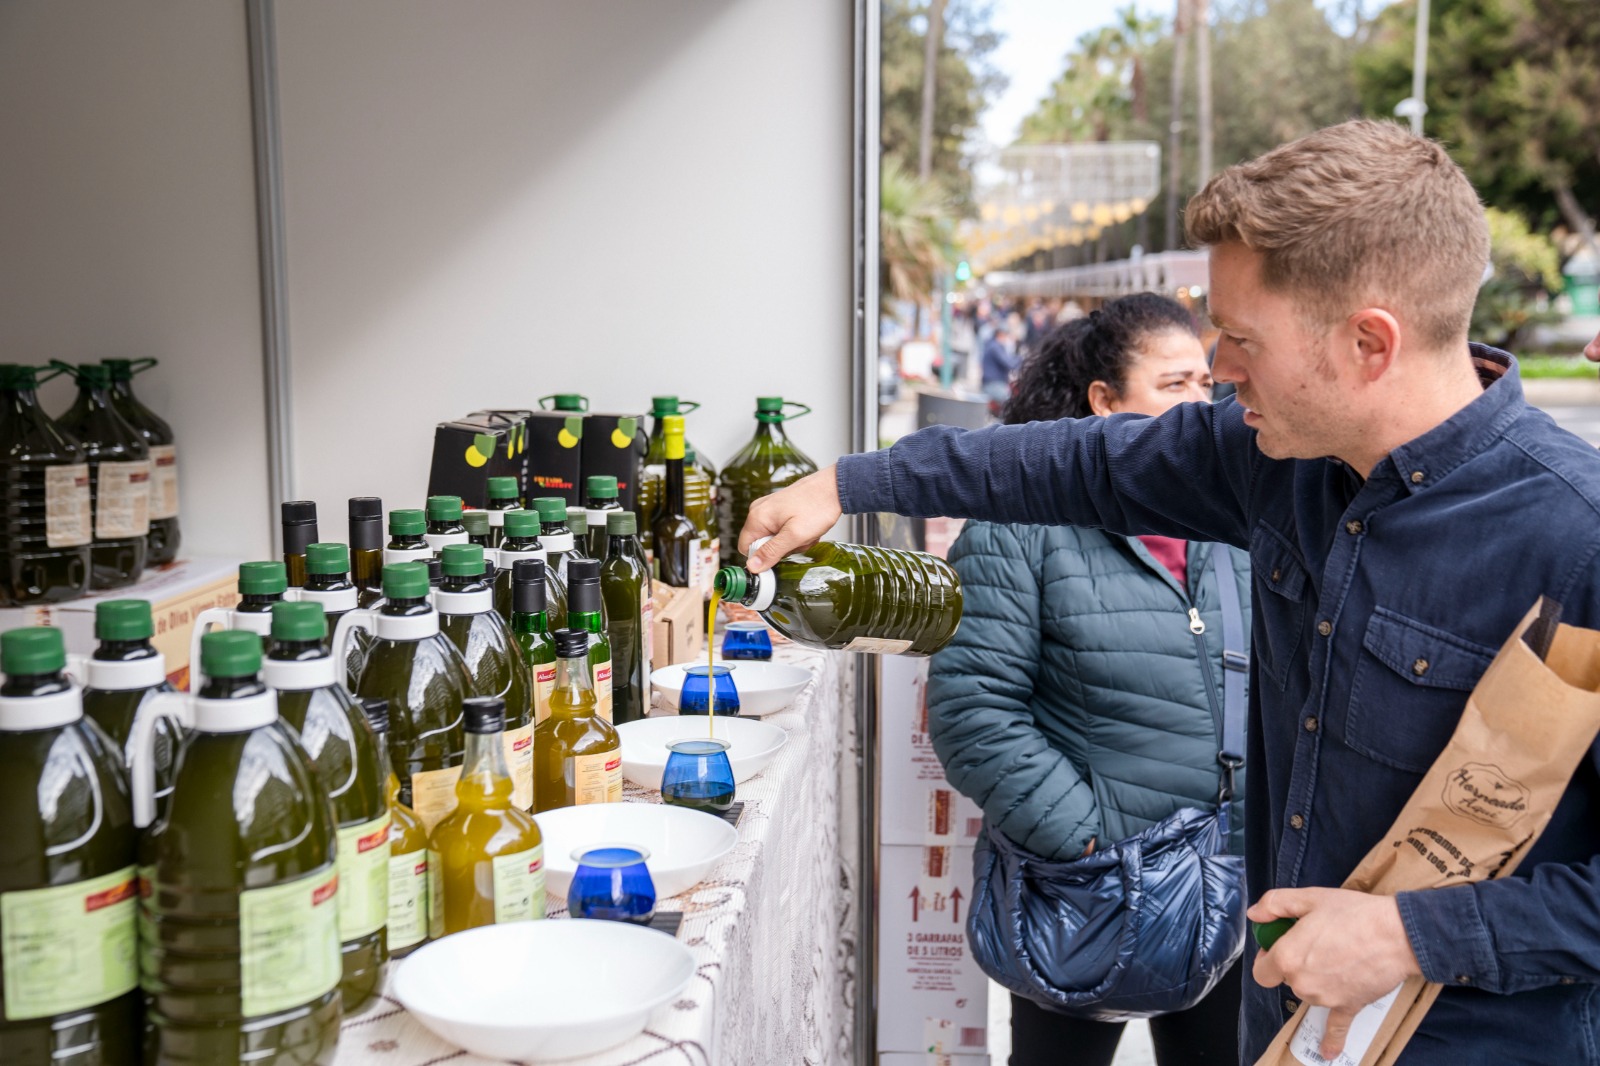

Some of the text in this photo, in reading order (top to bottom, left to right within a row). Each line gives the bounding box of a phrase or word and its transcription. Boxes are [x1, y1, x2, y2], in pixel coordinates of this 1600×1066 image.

[1426, 851, 1448, 874] todo
[915, 932, 963, 944] GARRAFAS
[907, 945, 919, 956] DE
[930, 946, 963, 957] LITROS
